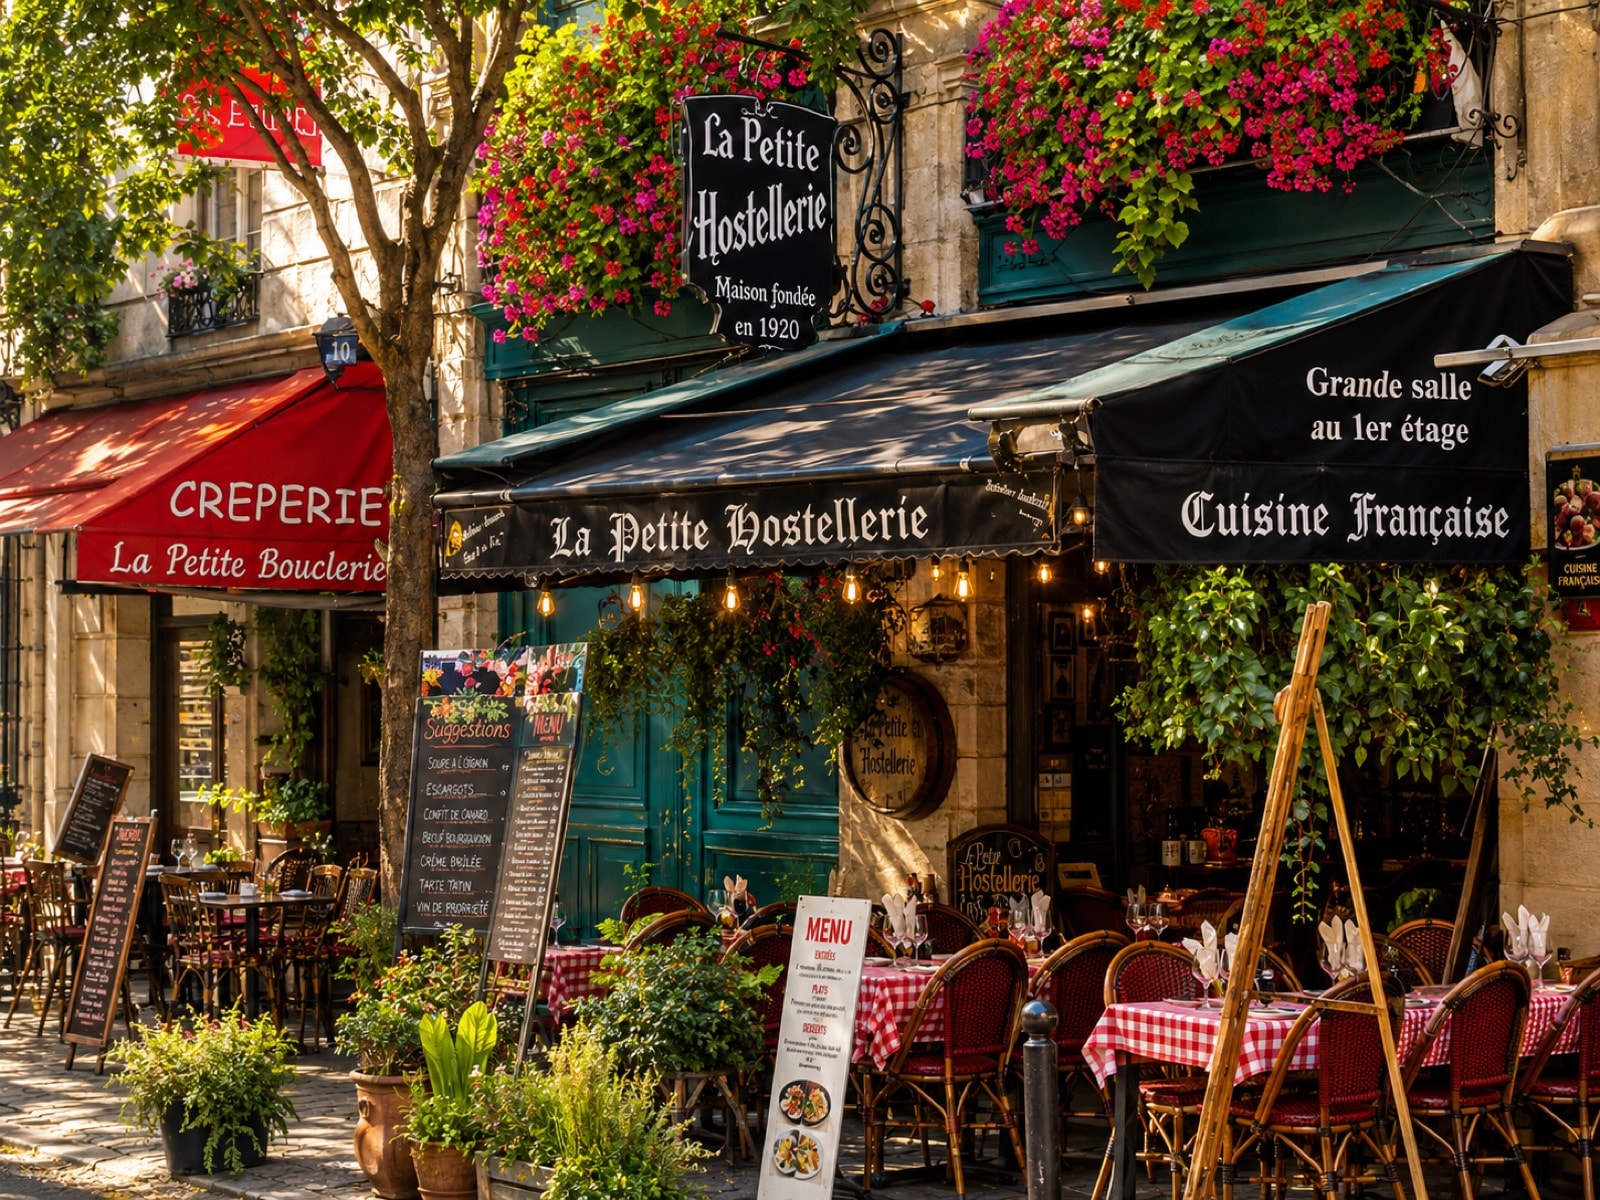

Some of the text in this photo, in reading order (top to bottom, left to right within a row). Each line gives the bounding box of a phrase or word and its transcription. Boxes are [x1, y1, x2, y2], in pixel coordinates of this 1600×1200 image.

[703, 112, 820, 172] La Petite
[693, 182, 827, 266] Hostellerie
[714, 275, 816, 309] Maison fondée
[735, 317, 800, 341] en 1920
[331, 341, 351, 362] 10
[1306, 366, 1472, 400] Grande salle
[1310, 413, 1469, 450] au 1er étage
[169, 481, 384, 526] CREPERIE
[1180, 490, 1510, 546] Cuisine Française
[549, 516, 592, 560] La
[608, 511, 711, 563] Petite
[726, 495, 930, 555] Hostellerie
[109, 541, 387, 582] La Petite Bouclerie
[1564, 563, 1598, 574] CUISINE
[1558, 575, 1600, 590] FRANÇAIS
[424, 718, 512, 745] Suggestions
[860, 746, 916, 776] Hostellerie
[425, 782, 475, 796] ESCARGOTS
[450, 809, 460, 820] DE
[419, 878, 472, 893] TARTE TATIN
[958, 864, 1042, 894] Hostellerie
[416, 901, 431, 913] VIN
[432, 902, 443, 914] DE
[805, 917, 853, 945] MENU
